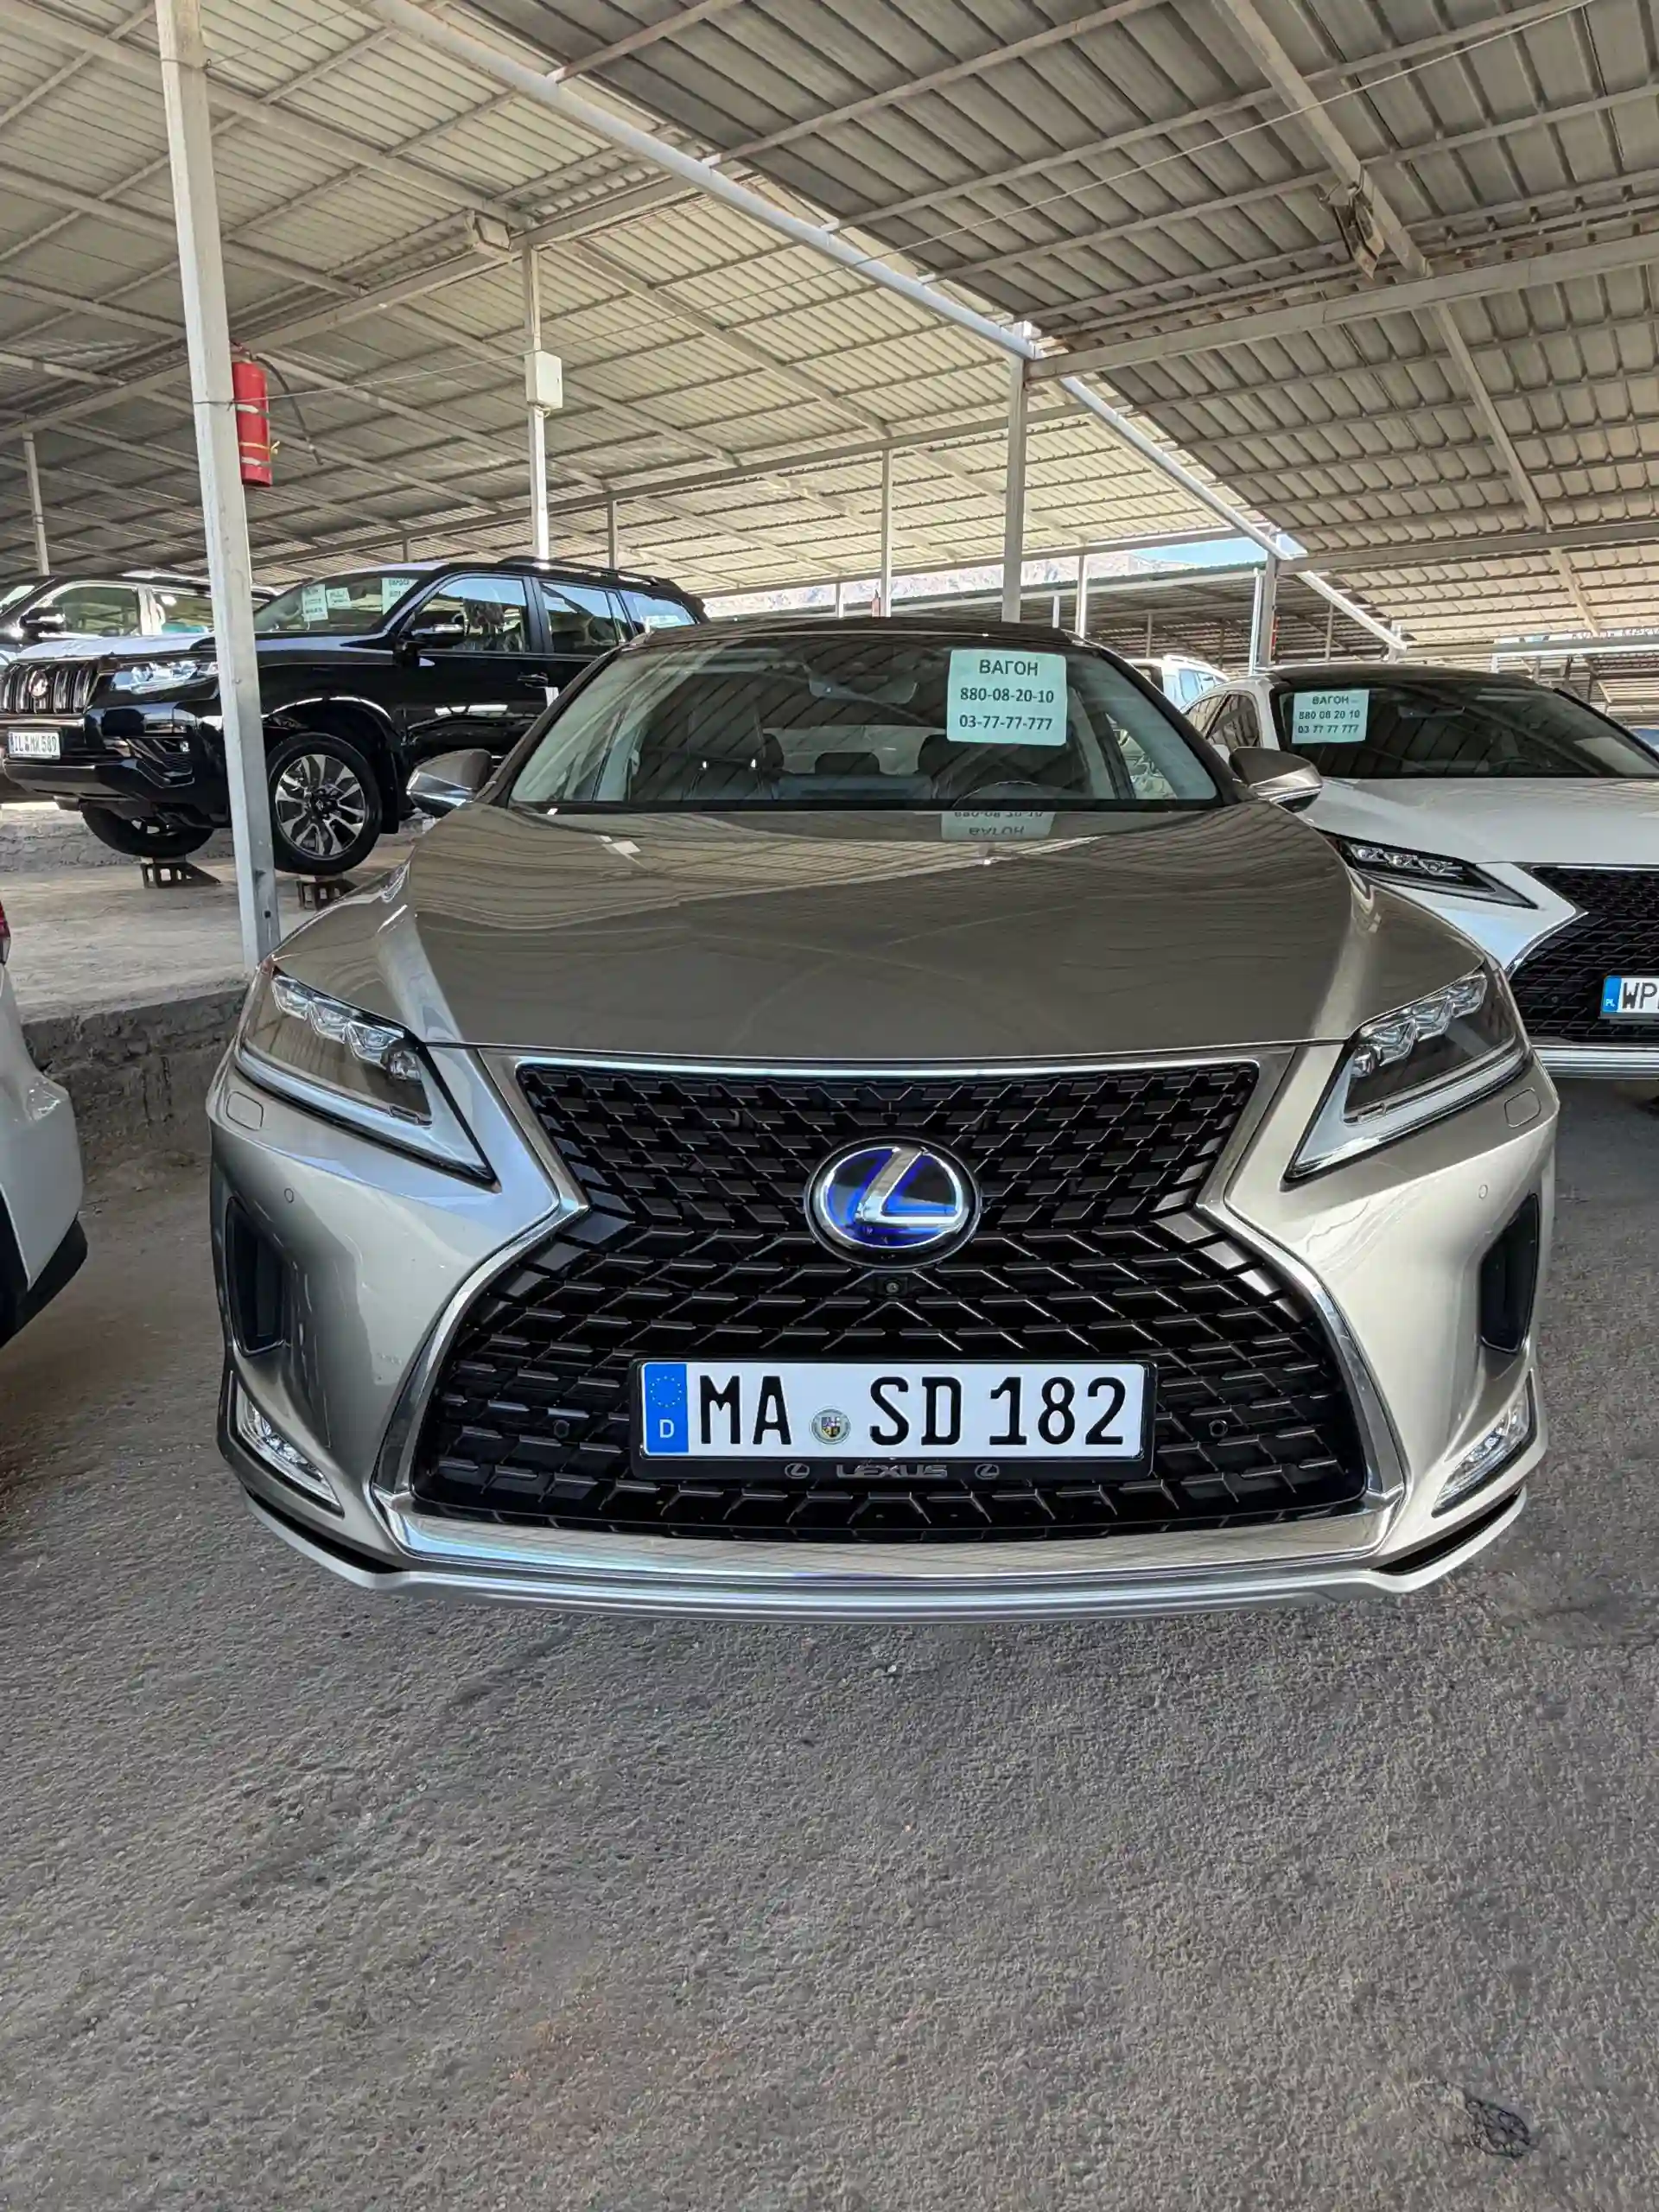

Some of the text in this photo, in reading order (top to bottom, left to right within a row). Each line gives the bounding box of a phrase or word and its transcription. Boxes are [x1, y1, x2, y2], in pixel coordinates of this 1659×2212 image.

[978, 658, 1039, 677] ВАГОН
[959, 687, 1055, 704] 880-08-20-10
[1312, 695, 1350, 705] ВАГОН
[958, 714, 1053, 731] 03-77-77-777
[1299, 709, 1361, 720] 880 08 20 10
[1298, 723, 1360, 734] 03 77 77 777
[1623, 982, 1659, 1010] WP
[699, 1374, 1125, 1446] MA SD 182
[659, 1418, 675, 1440] D
[836, 1464, 948, 1478] LEXUS
